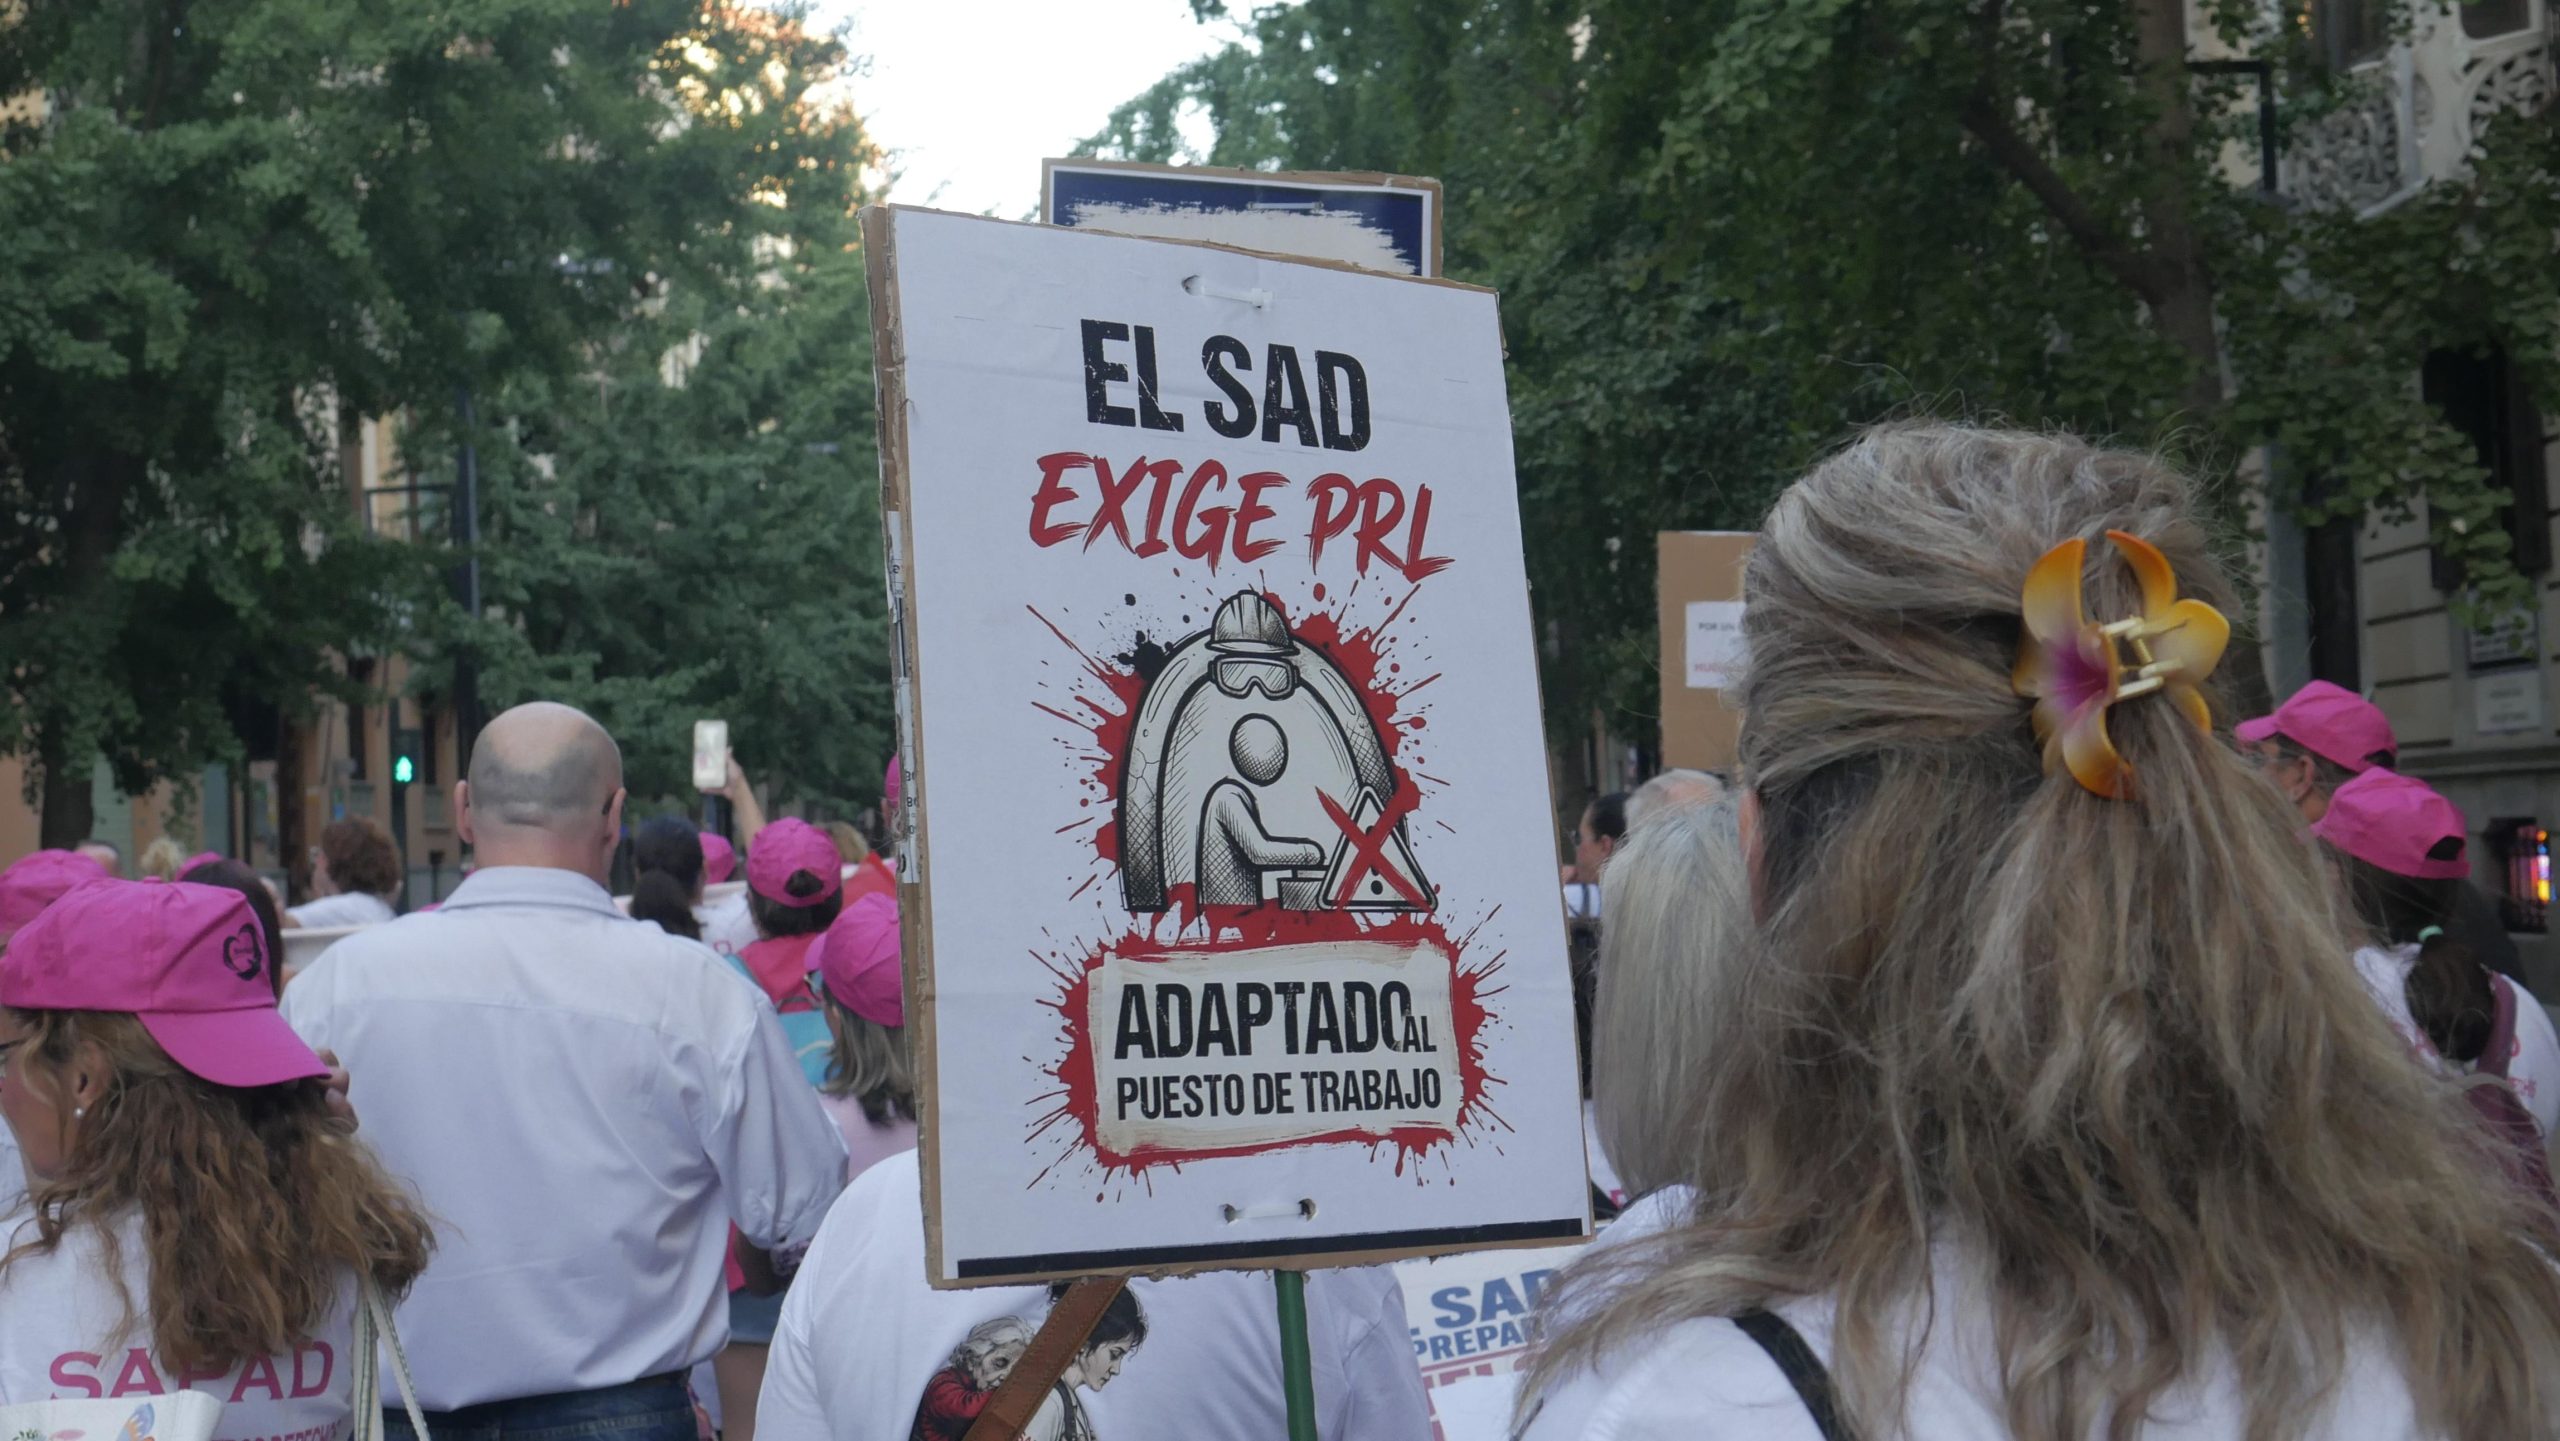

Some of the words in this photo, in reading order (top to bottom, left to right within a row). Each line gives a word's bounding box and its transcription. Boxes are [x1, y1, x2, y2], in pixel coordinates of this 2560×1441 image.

[1081, 319, 1184, 432] EL
[1201, 335, 1371, 452] SAD
[1030, 452, 1290, 577] EXIGE
[1304, 472, 1456, 584] PRL
[1114, 981, 1412, 1060] ADAPTADO
[1402, 1015, 1437, 1053] AL
[1117, 1074, 1244, 1121] PUESTO
[1253, 1072, 1294, 1115] DE
[1301, 1068, 1442, 1113] TRABAJO
